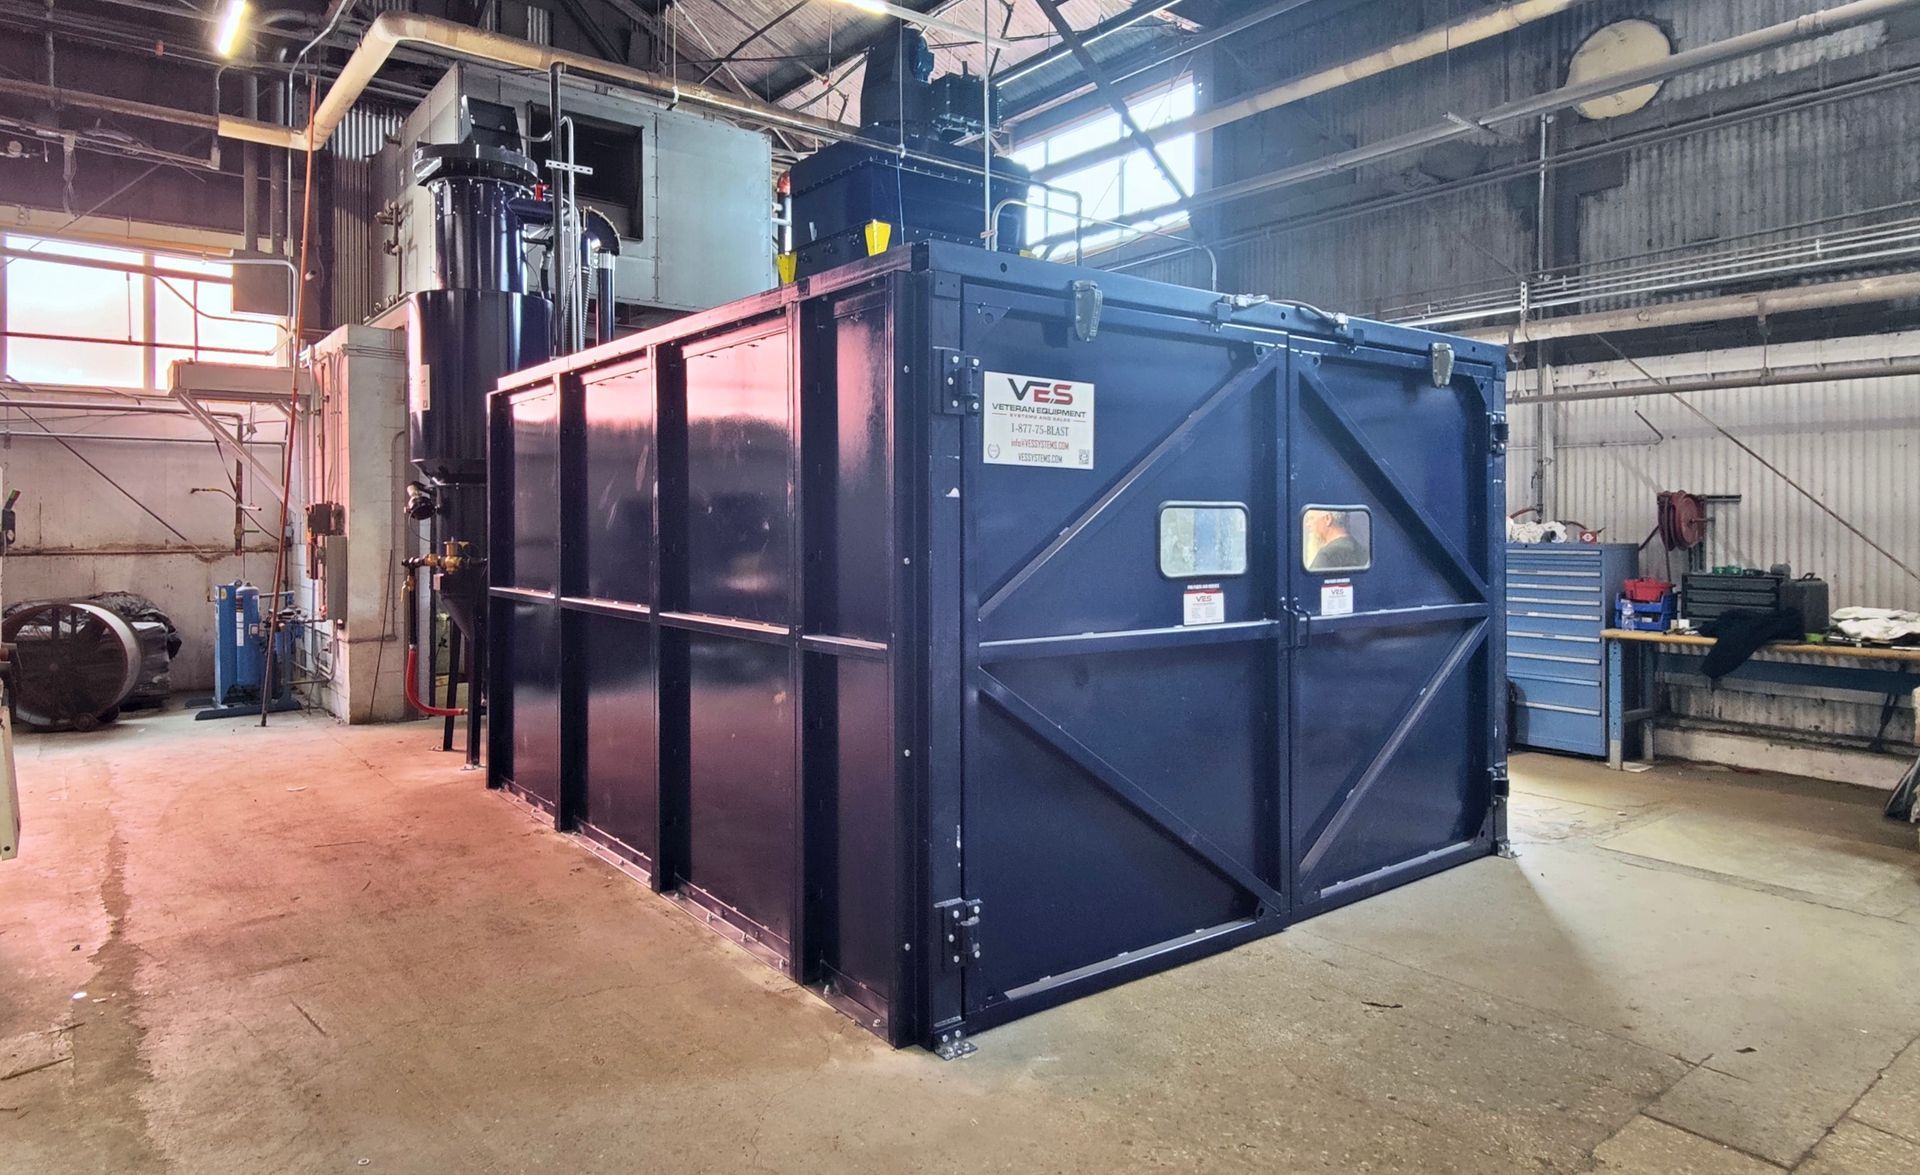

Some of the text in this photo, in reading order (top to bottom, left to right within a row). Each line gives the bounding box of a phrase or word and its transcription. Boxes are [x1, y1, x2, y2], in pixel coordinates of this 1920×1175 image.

[1008, 378, 1073, 405] VES
[992, 403, 1086, 418] VETERAN EQUIPMENT
[1011, 423, 1070, 437] 1-877-75-BLAST
[1018, 453, 1063, 464] VESSYSTEMS.COM
